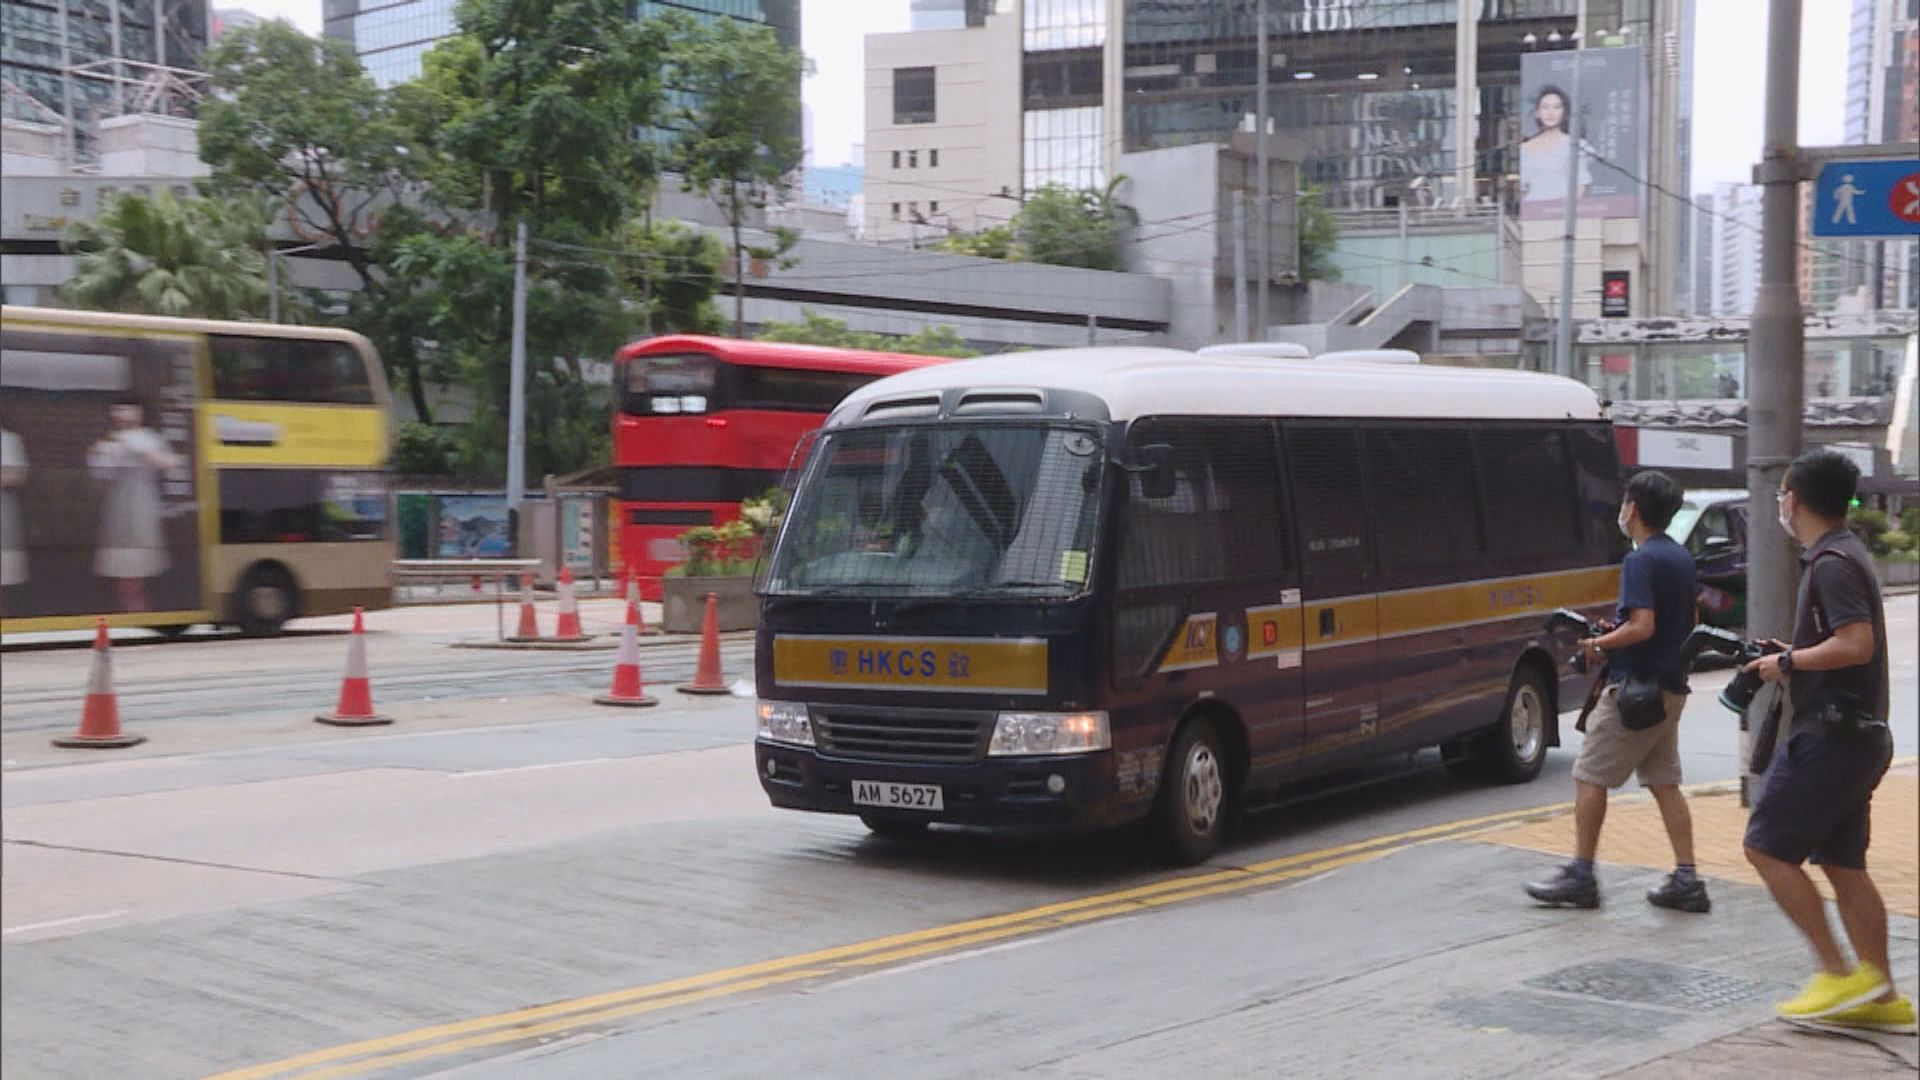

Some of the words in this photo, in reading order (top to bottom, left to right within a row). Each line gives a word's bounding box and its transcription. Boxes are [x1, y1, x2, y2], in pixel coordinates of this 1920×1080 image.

[857, 649, 936, 677] HKCS
[858, 783, 881, 803] AM
[889, 785, 937, 807] 5627
